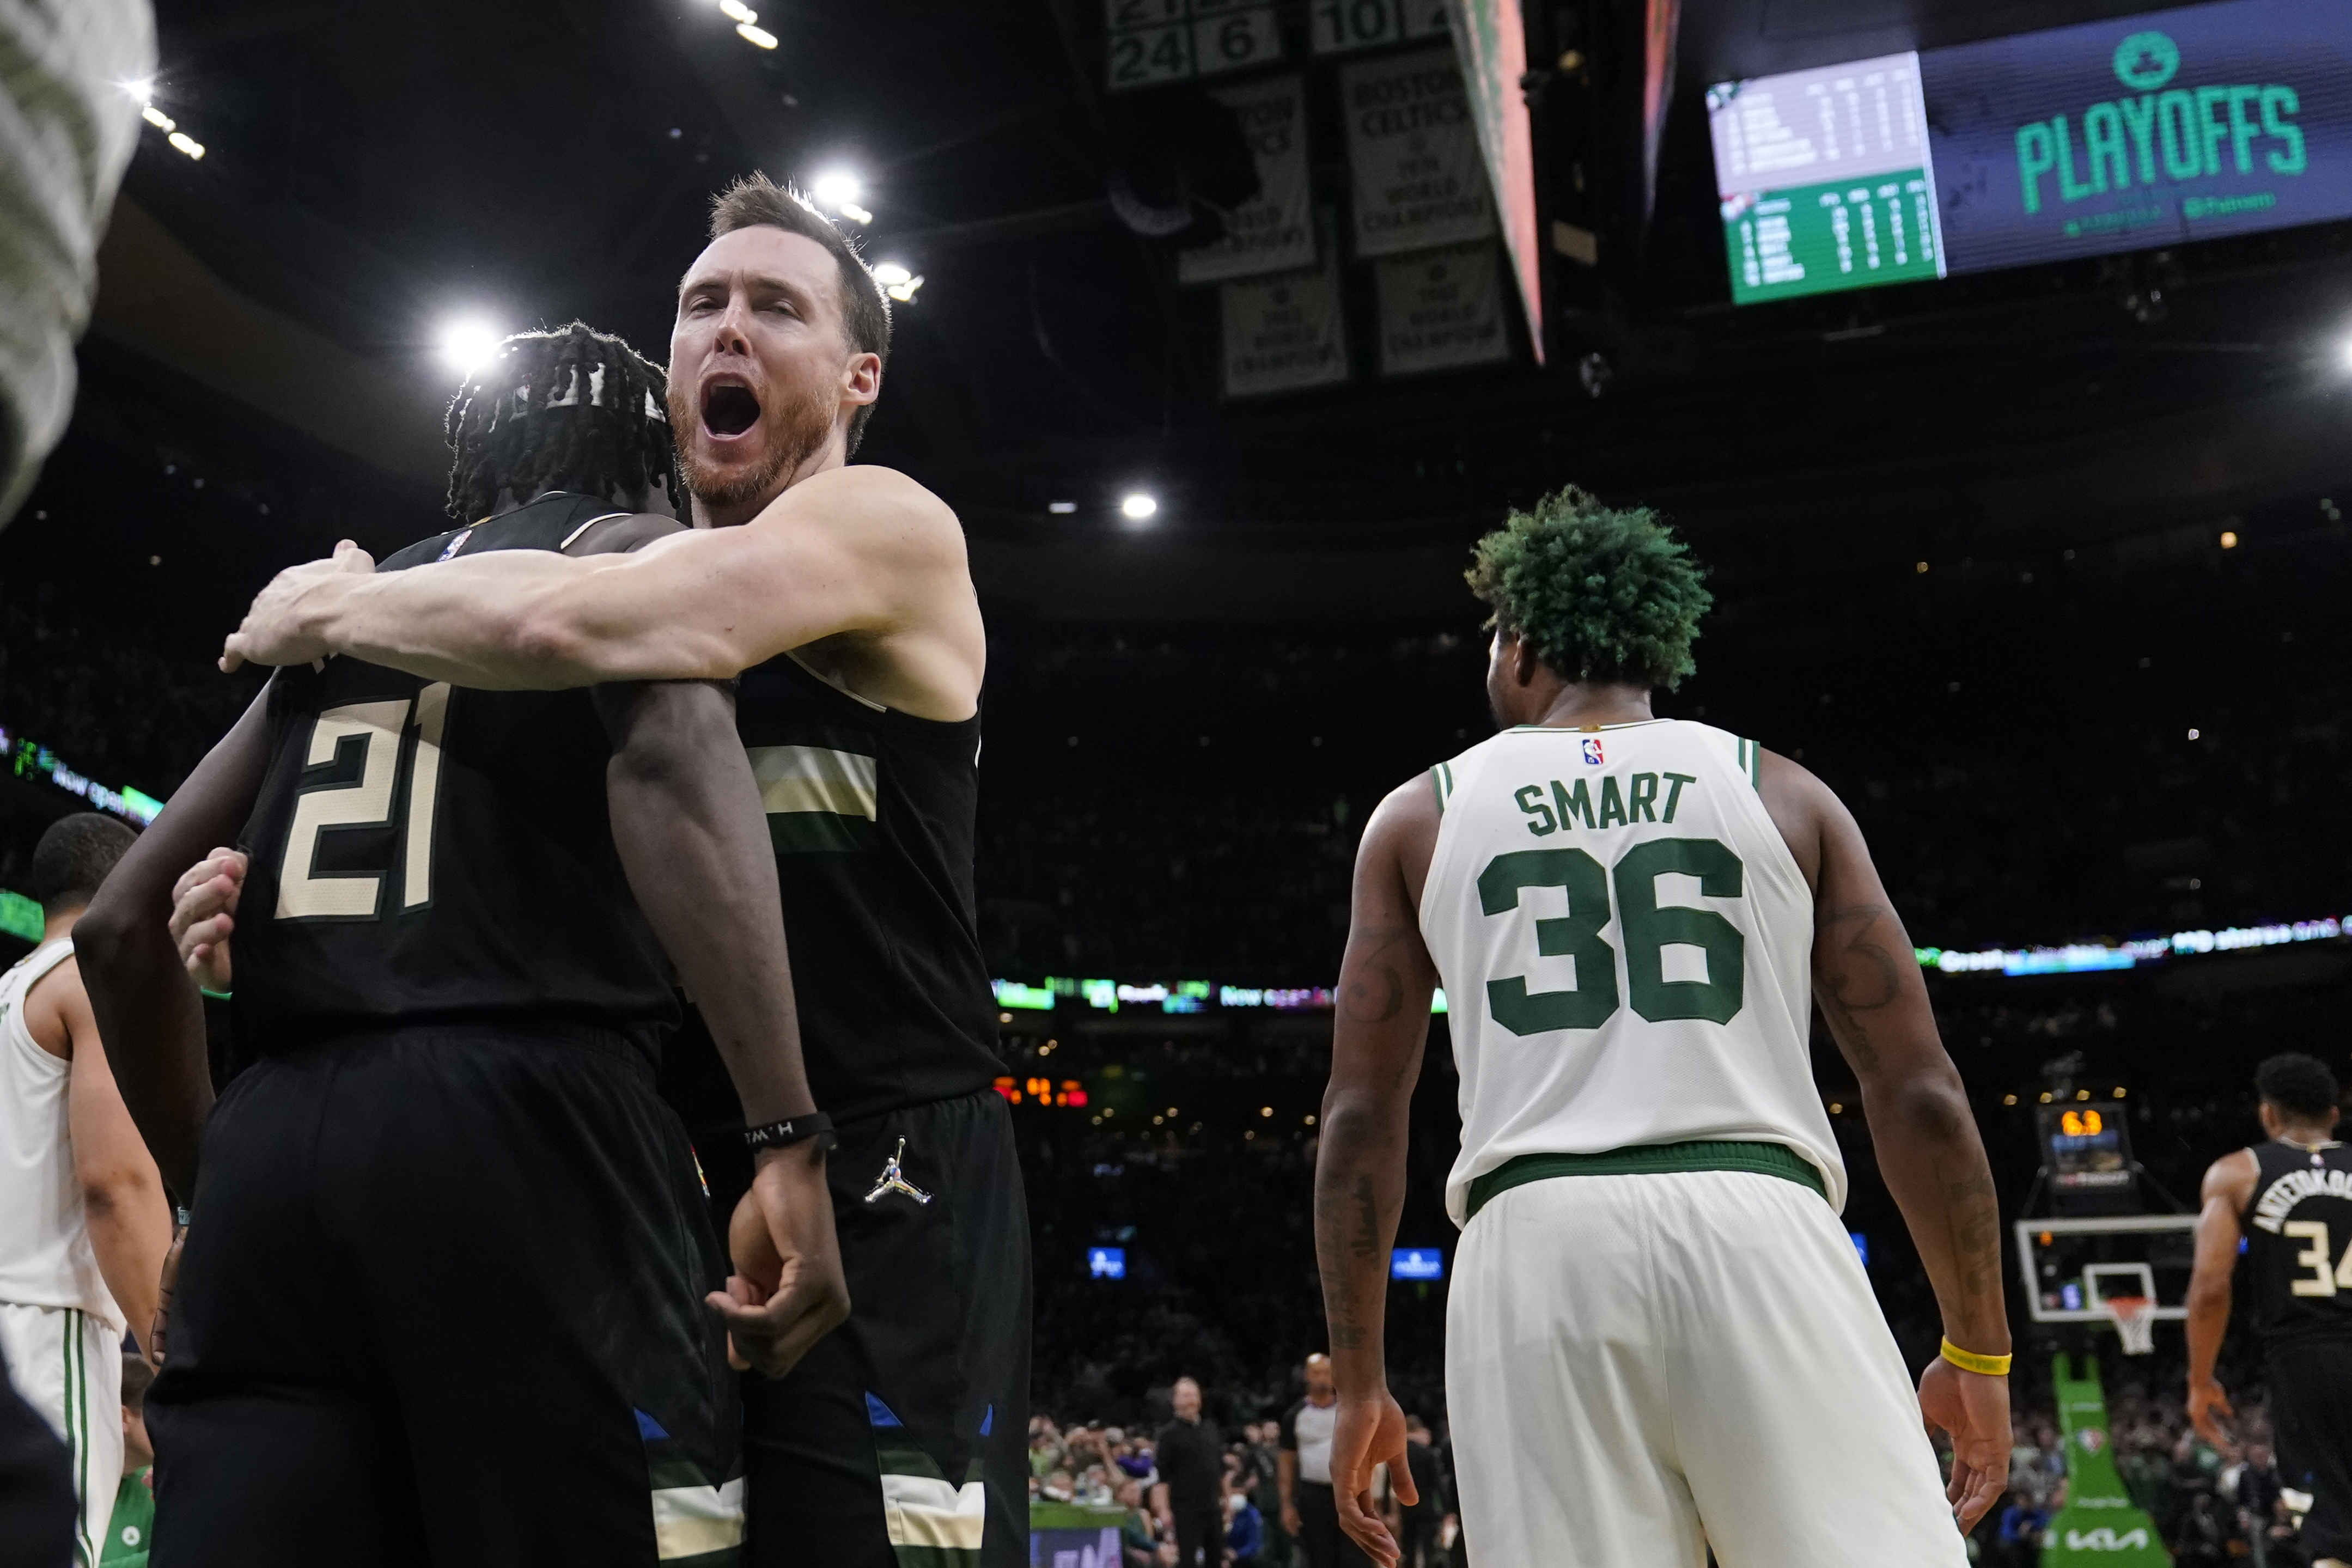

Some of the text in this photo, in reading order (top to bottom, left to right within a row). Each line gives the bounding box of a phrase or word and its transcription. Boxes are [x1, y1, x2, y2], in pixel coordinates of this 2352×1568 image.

[1220, 17, 1255, 60] 6
[1319, 0, 1387, 44] 10
[1114, 31, 1182, 82] 24
[2015, 84, 2308, 213] PLAYOFFS
[274, 681, 452, 920] 21
[1515, 772, 1696, 837] SMART
[1477, 838, 1744, 1036] 36
